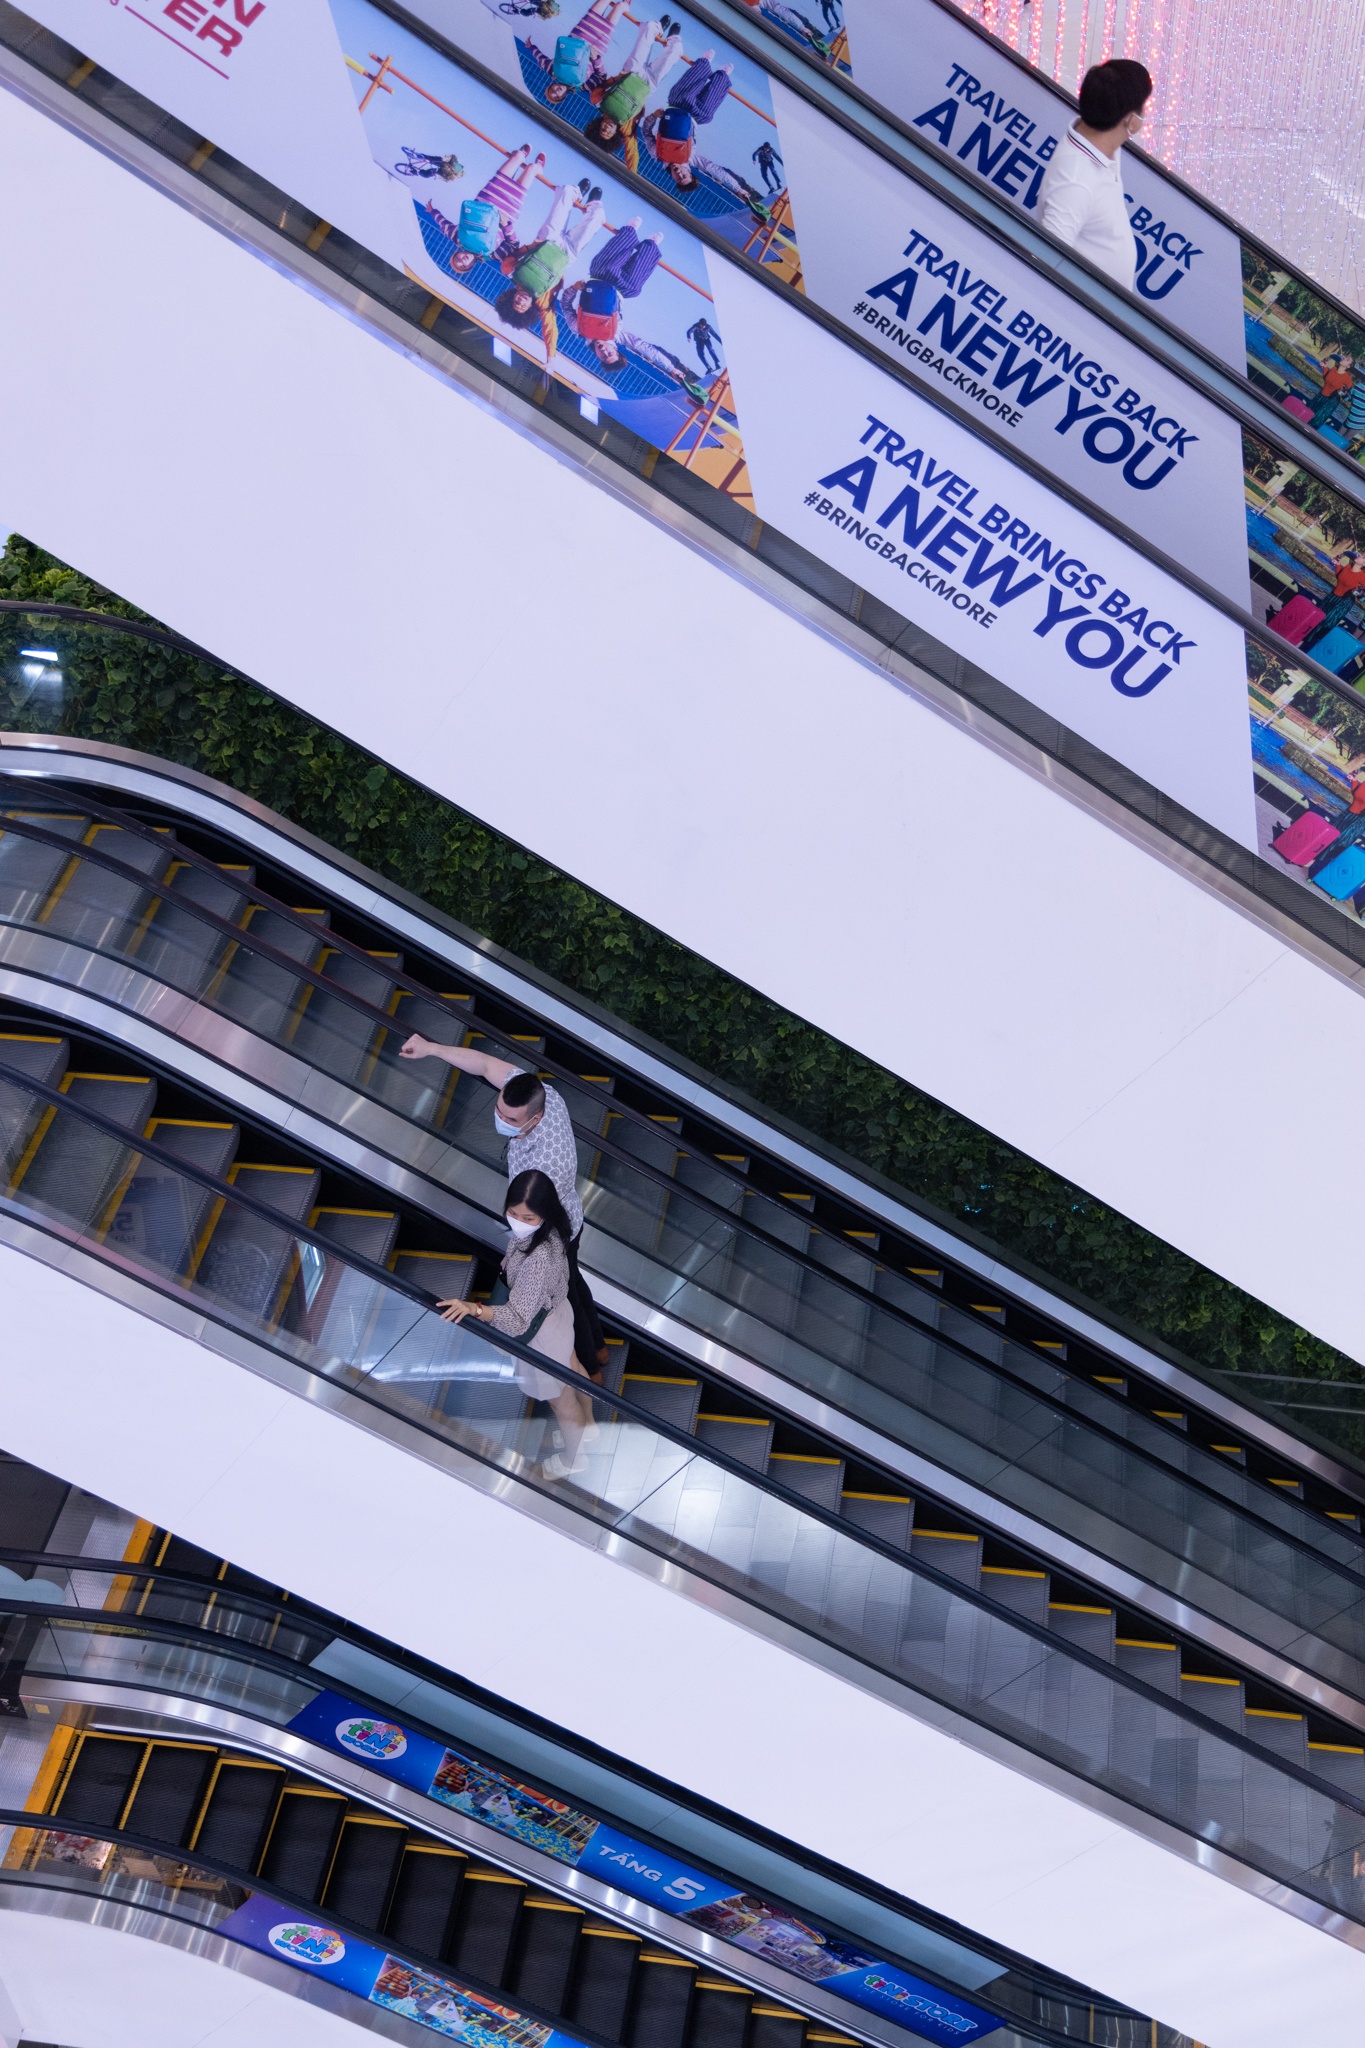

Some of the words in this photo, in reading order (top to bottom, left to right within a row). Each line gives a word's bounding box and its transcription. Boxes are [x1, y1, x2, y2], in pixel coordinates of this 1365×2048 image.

[912, 97, 960, 148] A
[956, 121, 1046, 210] NE
[944, 62, 1037, 149] TRAVEL
[1129, 205, 1205, 270] BACK
[852, 301, 1024, 428] #BRINGBACKMORE
[864, 266, 920, 322] A
[916, 293, 1065, 409] NEW
[1053, 384, 1178, 491] YOU
[901, 228, 1008, 325] TRAVEL
[1006, 309, 1120, 399] BRINGS
[1112, 387, 1200, 459] BACK
[803, 491, 998, 629] #BRINGBACKMORE
[816, 454, 879, 515] A
[875, 484, 1045, 609] NEW
[1032, 584, 1174, 698] YOU
[857, 414, 980, 519] TRAVEL
[977, 502, 1107, 600] BRINGS
[1097, 588, 1199, 665] BACK
[662, 1876, 706, 1900] 5
